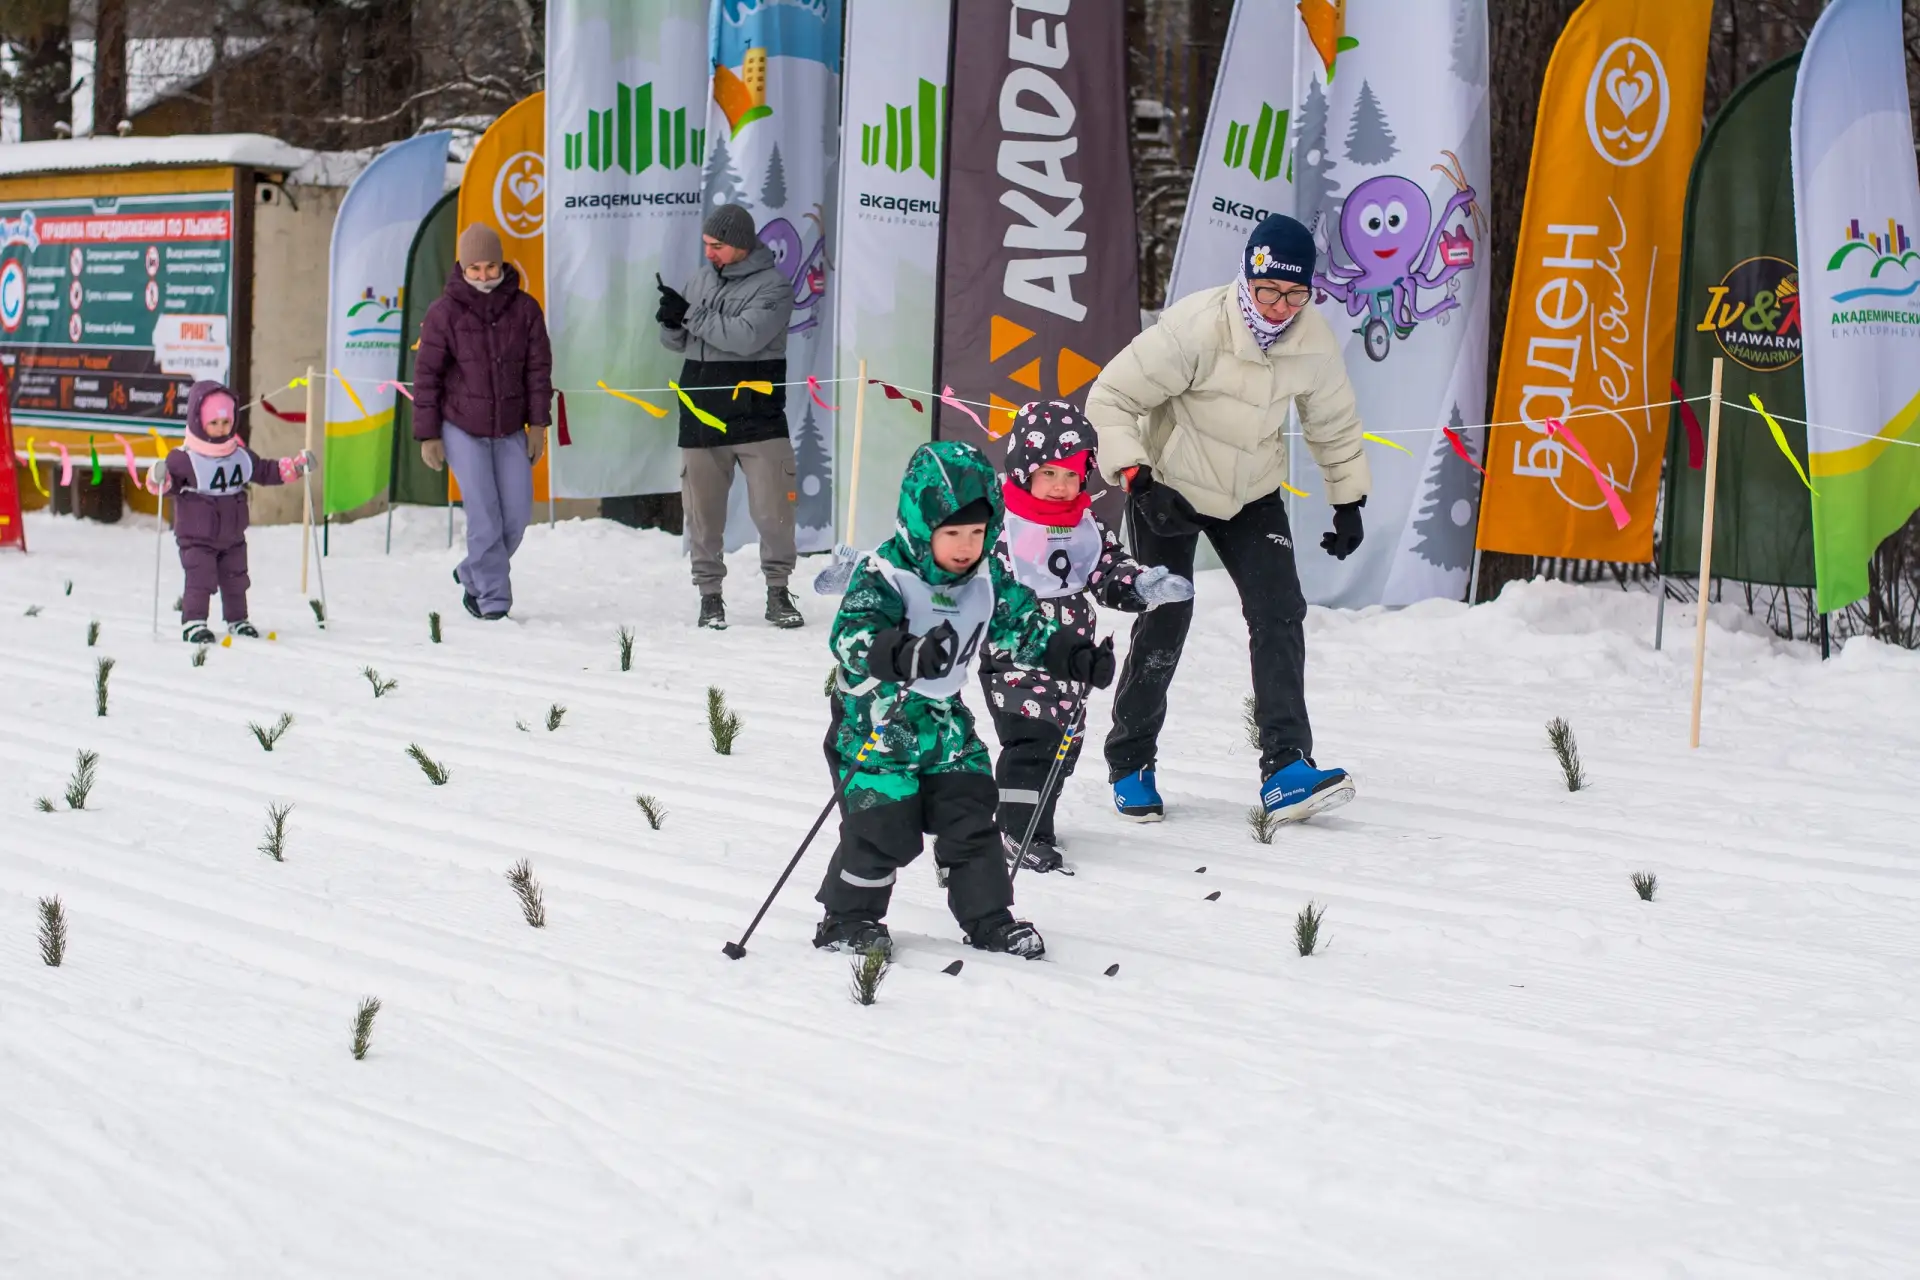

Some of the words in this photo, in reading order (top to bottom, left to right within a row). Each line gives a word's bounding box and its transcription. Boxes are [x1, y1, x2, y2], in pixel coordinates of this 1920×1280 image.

[997, 0, 1087, 322] AKADE
[1512, 224, 1599, 478] Баден
[209, 463, 244, 493] 44
[1047, 548, 1072, 589] 9
